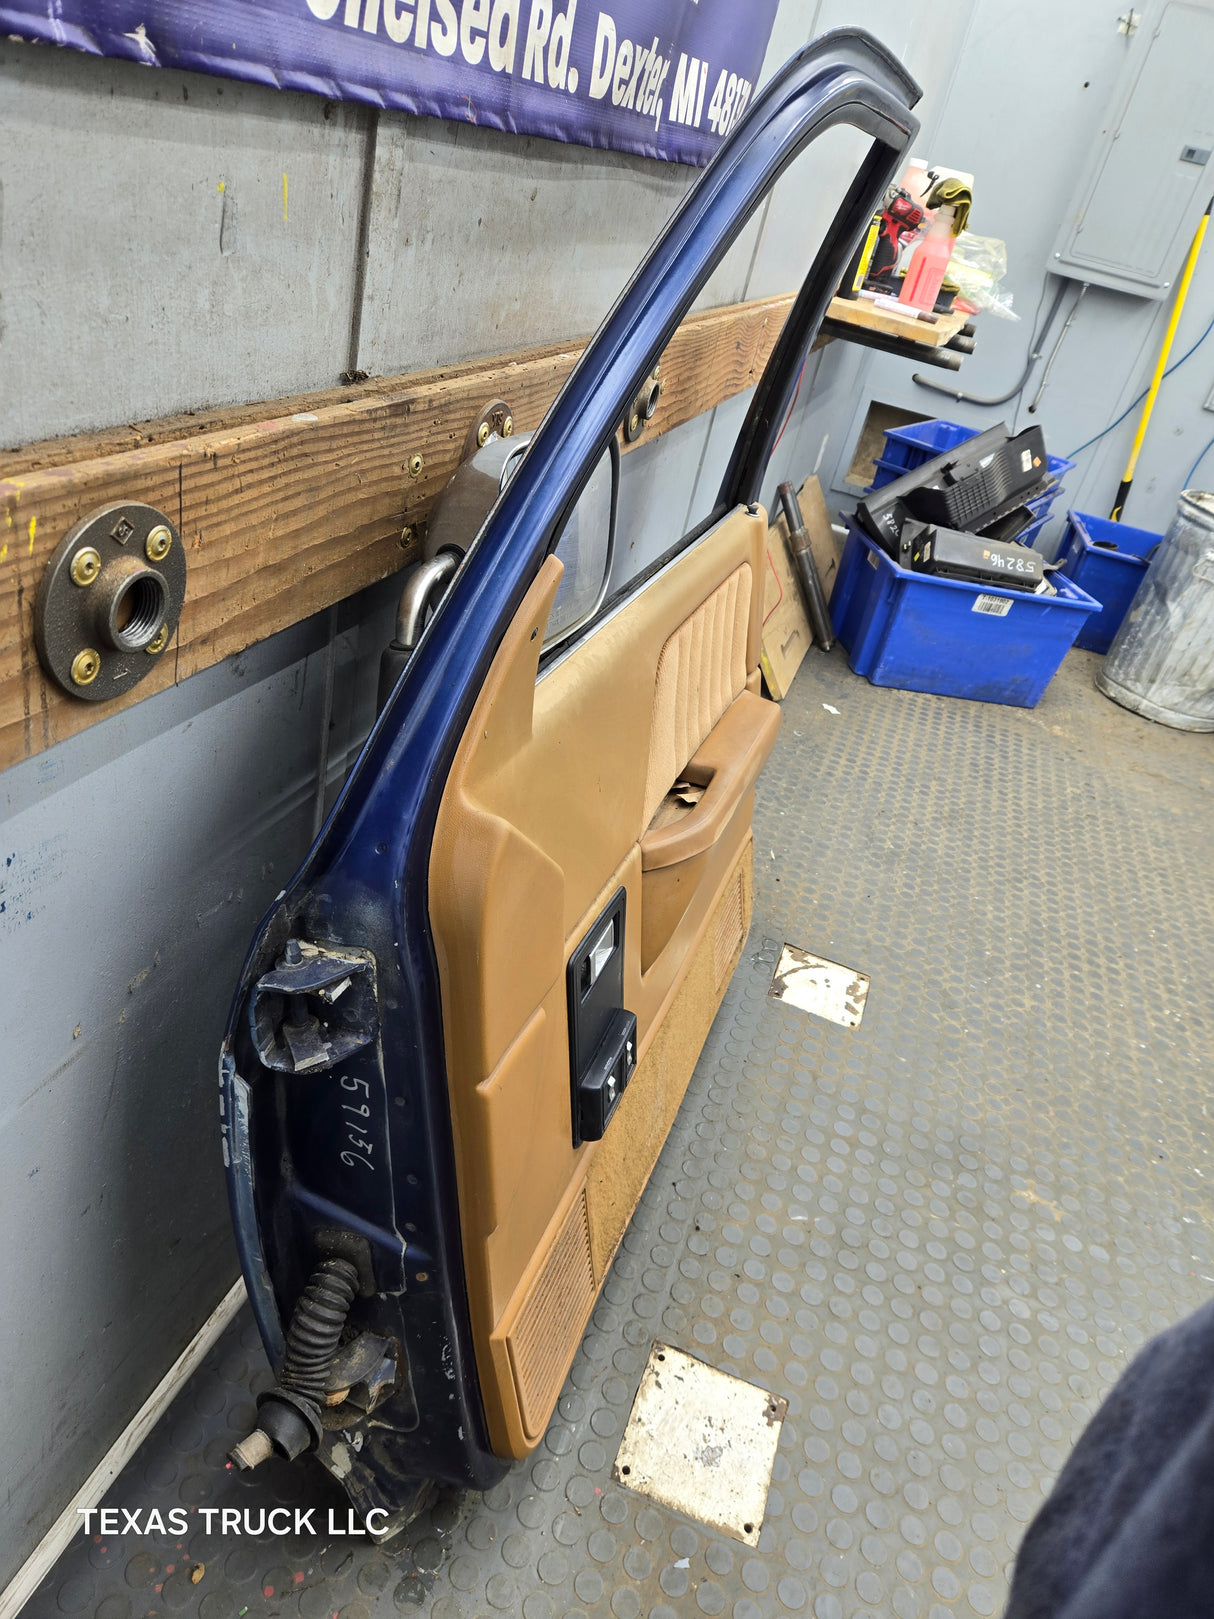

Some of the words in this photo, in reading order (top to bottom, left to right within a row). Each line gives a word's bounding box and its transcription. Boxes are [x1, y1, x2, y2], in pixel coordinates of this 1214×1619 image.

[522, 0, 579, 94] Rd.
[589, 11, 671, 132] Dexter,
[669, 52, 709, 128] MI
[990, 553, 1036, 573] 58246
